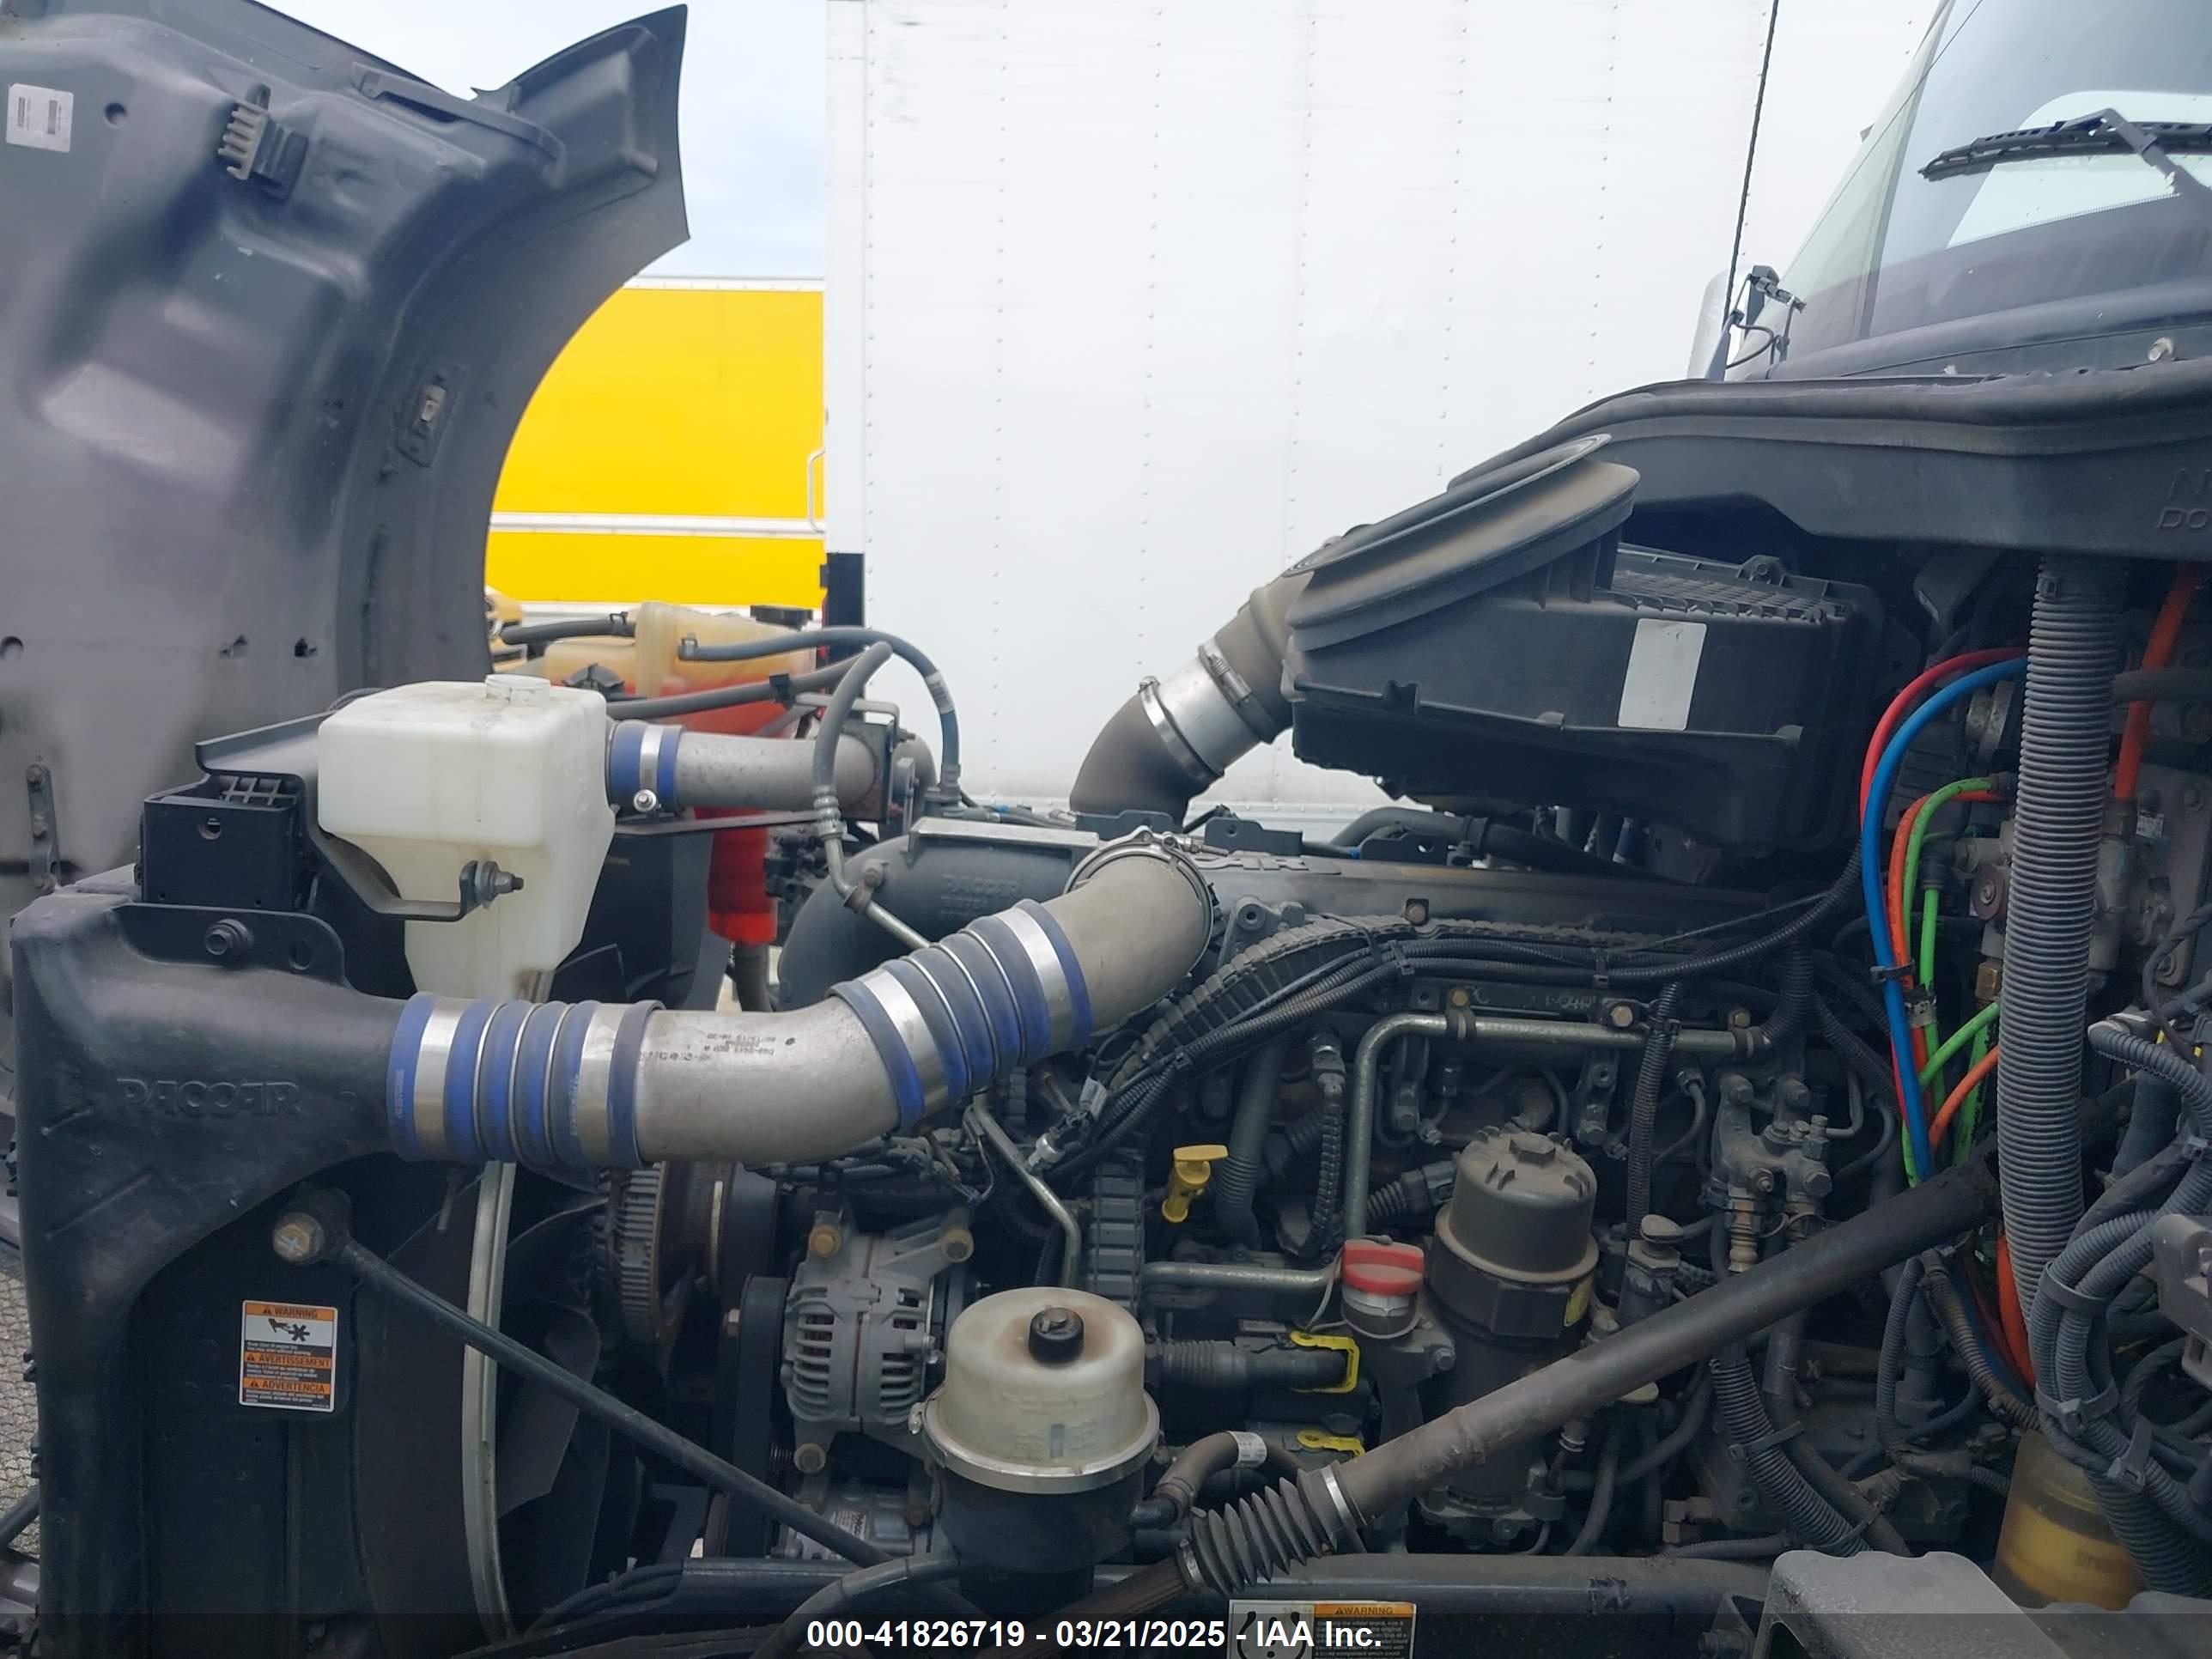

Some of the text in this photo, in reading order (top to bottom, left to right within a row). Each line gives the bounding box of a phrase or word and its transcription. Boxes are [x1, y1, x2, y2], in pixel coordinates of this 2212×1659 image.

[116, 1078, 302, 1115] PACCAR
[274, 1306, 319, 1319] WARNING
[258, 1353, 330, 1368] AVERTISSEMENT
[261, 1380, 325, 1393] ADVERTENCIA
[1345, 1607, 1394, 1615] WARNING
